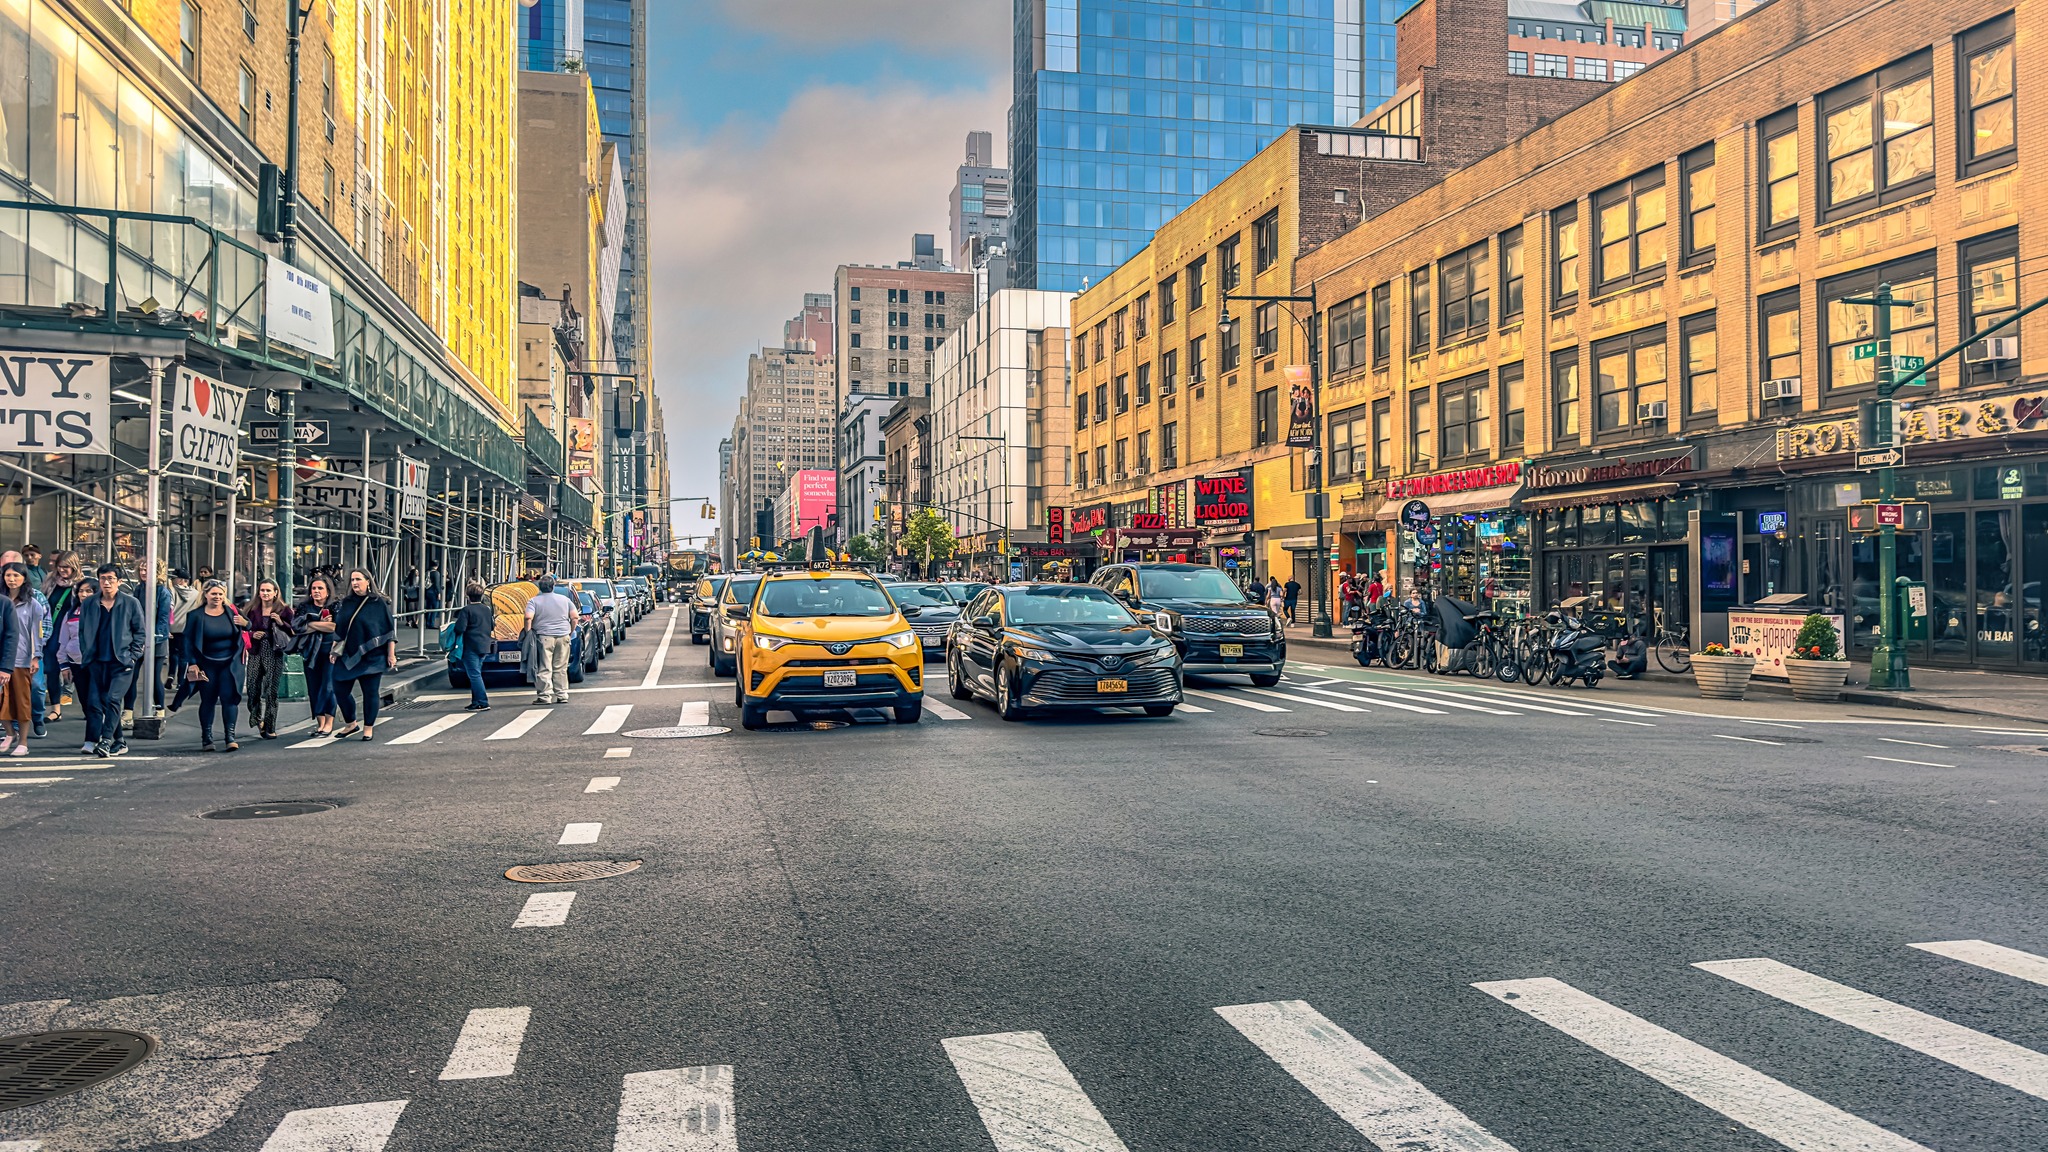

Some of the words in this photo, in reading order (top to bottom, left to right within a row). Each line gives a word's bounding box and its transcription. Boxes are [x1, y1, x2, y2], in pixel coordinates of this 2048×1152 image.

[1859, 346, 1864, 358] 8
[1900, 357, 1906, 369] W
[1908, 358, 1916, 369] 45
[182, 372, 192, 413] I
[212, 384, 244, 426] NY
[0, 408, 93, 449] TS
[1906, 406, 1966, 443] AR
[1976, 402, 2003, 434] &
[261, 428, 279, 438] ON
[294, 428, 316, 438] WAY
[180, 423, 236, 469] GIFTS
[1862, 456, 1876, 464] ONE
[1882, 454, 1897, 462] WAY
[405, 462, 409, 486] I
[415, 464, 427, 490] NY
[620, 448, 630, 492] WESTIN
[1538, 465, 1589, 487] forno
[1632, 456, 1692, 477] KITCHEN
[804, 482, 828, 490] perfect
[1196, 478, 1248, 495] WINE
[1406, 473, 1457, 497] CONVENIENCE
[1465, 466, 1494, 489] SMOKE
[1496, 463, 1519, 484] SHOP
[1916, 480, 1952, 492] PERONI
[1218, 494, 1226, 502] &
[404, 494, 425, 518] GIFTS
[1196, 503, 1249, 520] LIQUOR
[1090, 508, 1106, 528] BAR
[1133, 514, 1166, 528] PIZZA
[1764, 514, 1782, 522] BUD
[1050, 548, 1064, 556] BAR
[1732, 626, 1751, 636] LITTLE
[1978, 630, 1992, 641] ON
[1734, 635, 1749, 644] SHOP
[1763, 627, 1800, 653] HORROR
